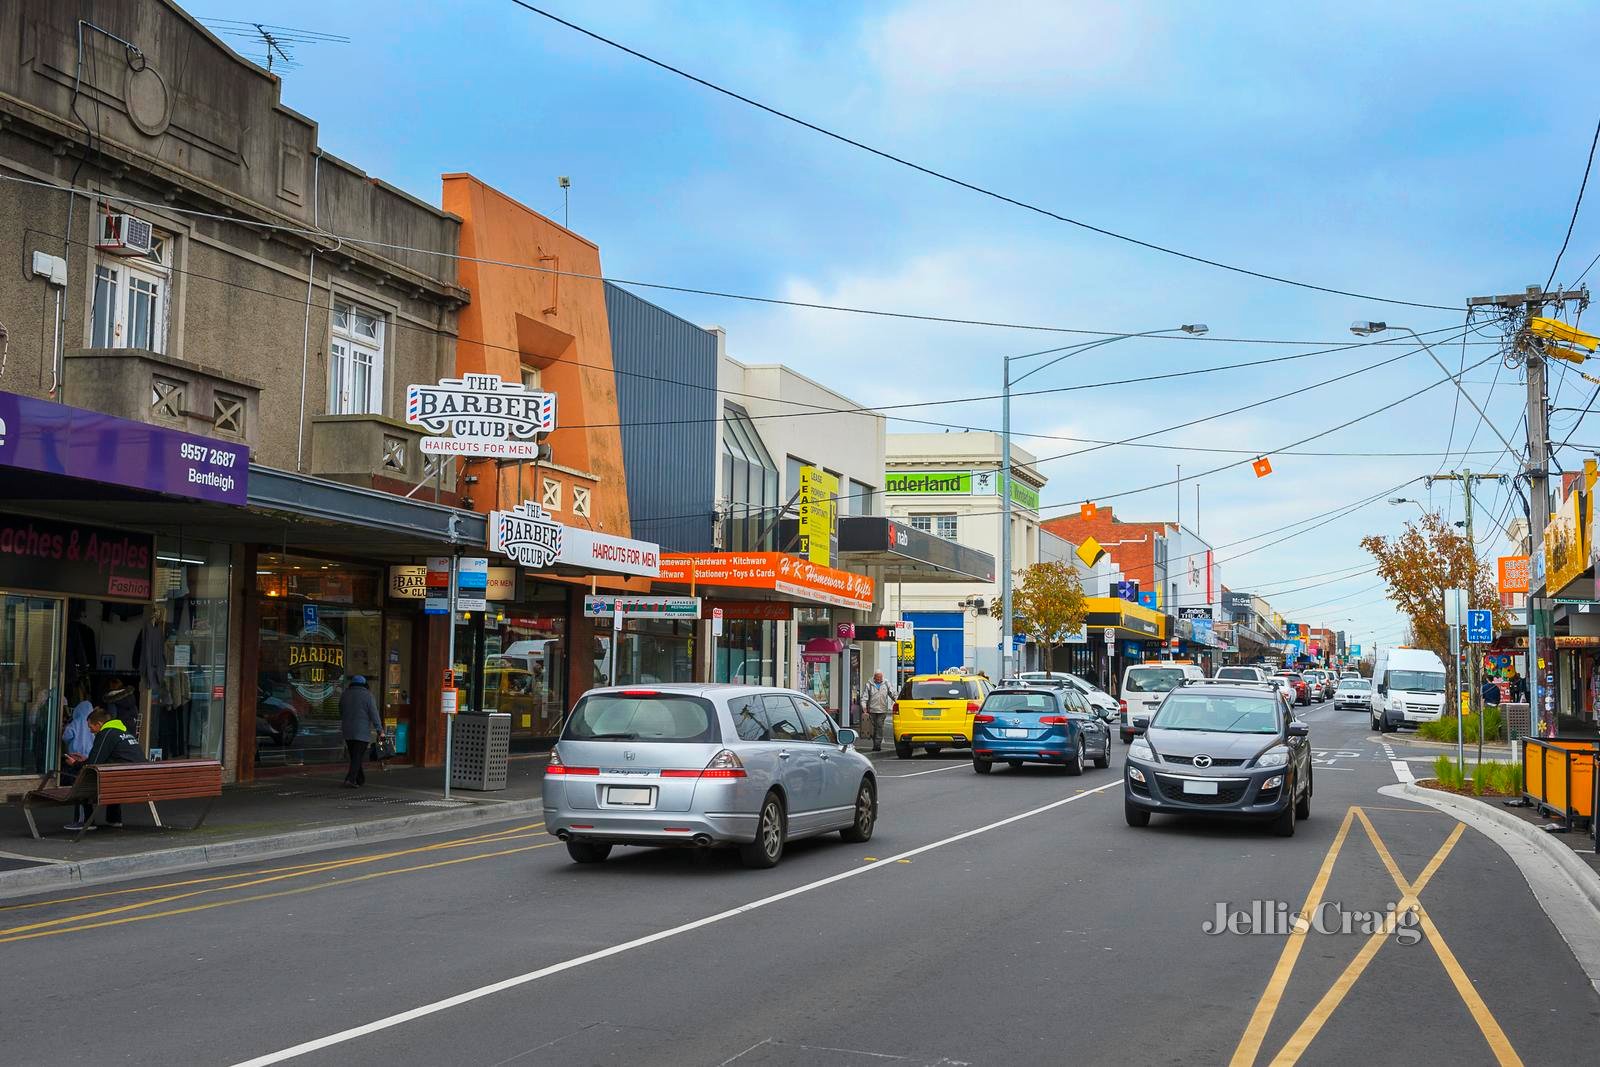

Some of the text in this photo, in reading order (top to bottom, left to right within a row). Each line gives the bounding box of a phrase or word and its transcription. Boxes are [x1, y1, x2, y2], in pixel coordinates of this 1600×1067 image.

[467, 376, 498, 391] THE
[418, 392, 541, 423] BARBER
[455, 420, 505, 437] CLUB
[180, 442, 236, 468] 9557 2687
[425, 440, 532, 455] HAIRCUTS FOR MEN
[188, 468, 235, 492] Bentleigh
[885, 475, 961, 492] nderland
[801, 475, 809, 525] LEASE
[525, 503, 541, 520] THE
[504, 518, 559, 551] BARBER
[897, 530, 909, 546] nab
[66, 528, 82, 562] &
[83, 533, 149, 579] Apples
[519, 547, 543, 566] CLUB
[592, 542, 658, 568] HAIRCUTS FOR MEN
[694, 556, 727, 566] Hardware
[732, 556, 767, 566] Kitchware
[416, 567, 426, 575] TH
[694, 568, 729, 579] Stationery
[732, 568, 749, 578] Toys
[748, 568, 755, 578] &
[755, 568, 776, 578] Cards
[779, 556, 791, 575] H
[793, 560, 803, 580] K
[804, 563, 846, 591] Homeware
[846, 575, 854, 592] &
[854, 577, 872, 600] Gifts
[110, 579, 150, 595] Fashion
[396, 576, 427, 588] BAR
[487, 579, 513, 587] FOR MEN
[411, 588, 427, 597] CLU
[1474, 612, 1485, 627] P
[289, 645, 344, 669] BARBER
